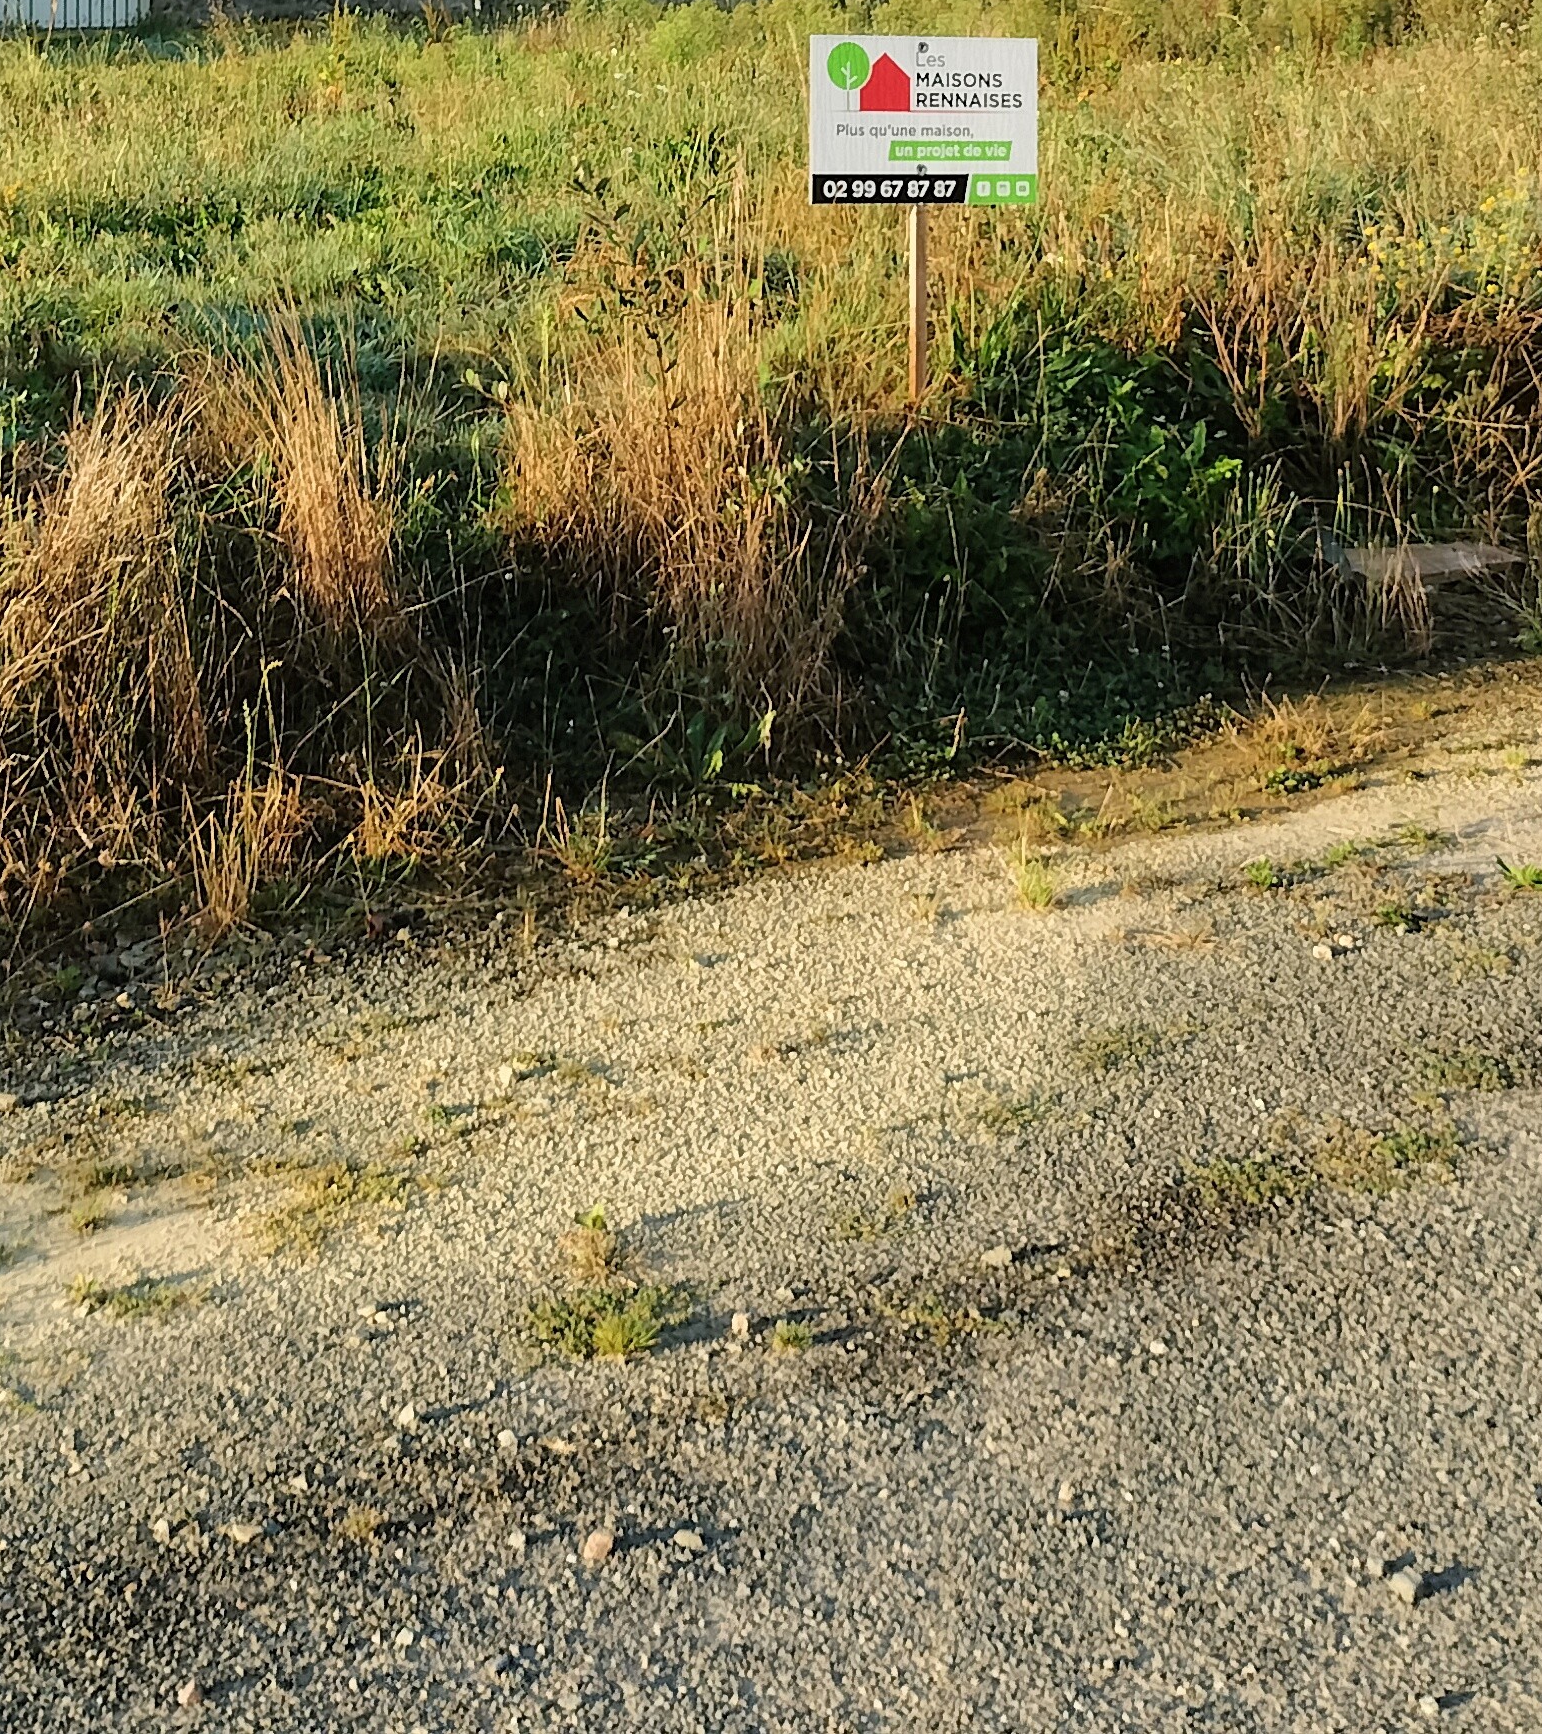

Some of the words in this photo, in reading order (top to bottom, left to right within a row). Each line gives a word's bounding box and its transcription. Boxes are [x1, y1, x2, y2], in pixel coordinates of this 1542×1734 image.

[915, 51, 946, 68] Les
[915, 72, 1003, 88] MAISONS
[915, 93, 1023, 109] RENNAISES
[836, 124, 865, 137] Plus
[869, 124, 917, 142] qu'une
[920, 124, 974, 139] maison,
[895, 146, 913, 157] un
[917, 143, 961, 161] projet
[963, 143, 981, 157] de
[984, 143, 1008, 157] vie
[823, 180, 848, 198] 02
[851, 180, 876, 198] 99
[880, 180, 904, 198] 67
[907, 180, 930, 198] 87
[933, 180, 957, 198] 87
